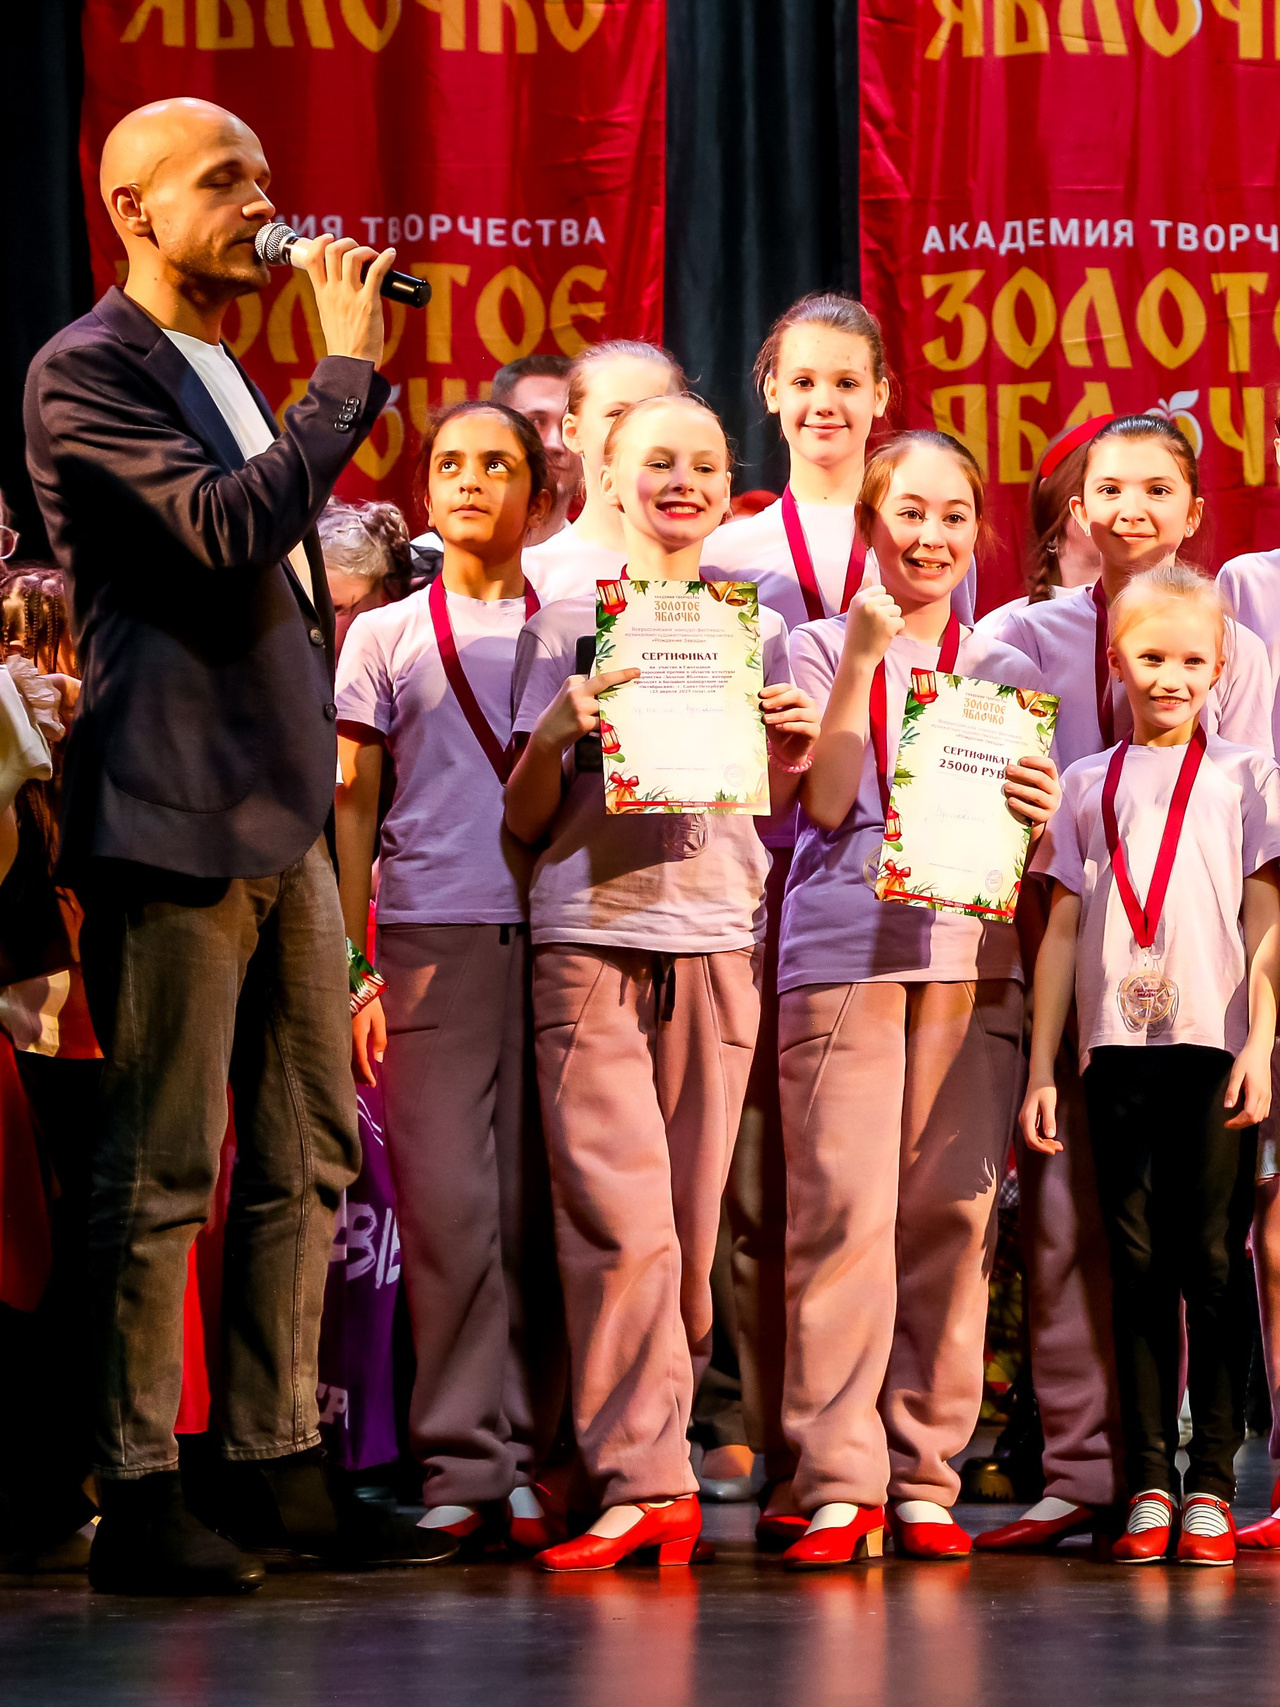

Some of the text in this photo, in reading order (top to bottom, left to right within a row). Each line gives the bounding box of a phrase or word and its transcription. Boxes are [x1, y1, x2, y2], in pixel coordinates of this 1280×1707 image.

[361, 216, 606, 247] ТВОРЧЕСТВА
[922, 218, 1135, 255] АКАДЕМИЯ
[654, 600, 700, 611] ЗОЛОТОЕ
[654, 611, 700, 622] ЯБЛОЧКО
[642, 652, 718, 661] СЕРТИФИКАТ
[964, 698, 1006, 715] ЗОЛОТОЕ
[962, 708, 1004, 725] ЯБЛОЧКО
[943, 745, 1012, 766] СЕРТИФИКАТ
[938, 758, 978, 774] 25000
